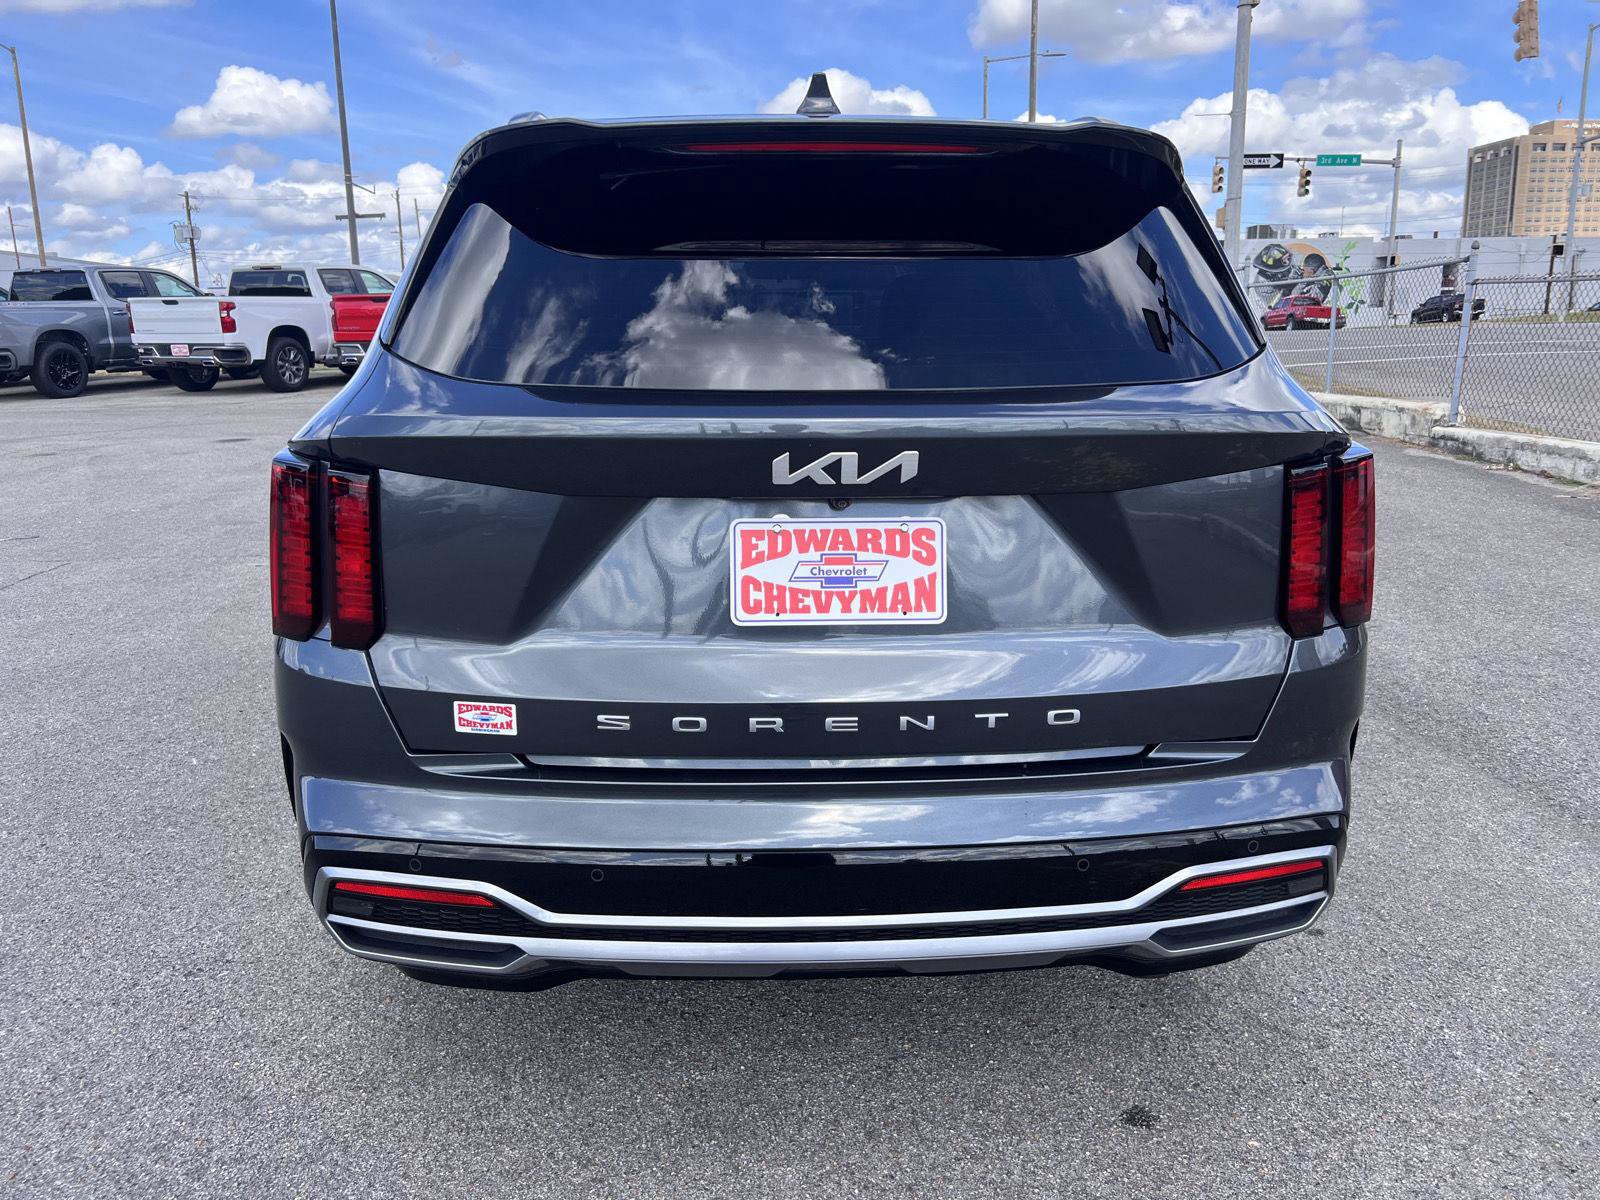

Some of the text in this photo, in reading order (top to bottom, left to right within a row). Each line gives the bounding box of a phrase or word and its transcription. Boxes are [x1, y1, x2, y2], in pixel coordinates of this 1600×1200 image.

[772, 450, 919, 485] KIA
[740, 527, 937, 570] EDWARDS
[810, 566, 867, 576] Chevrolet
[740, 571, 937, 615] CHEVYMAN
[457, 703, 513, 718] EDWARDS
[458, 716, 513, 730] CHEVYMAN
[597, 708, 1081, 733] SORENTO
